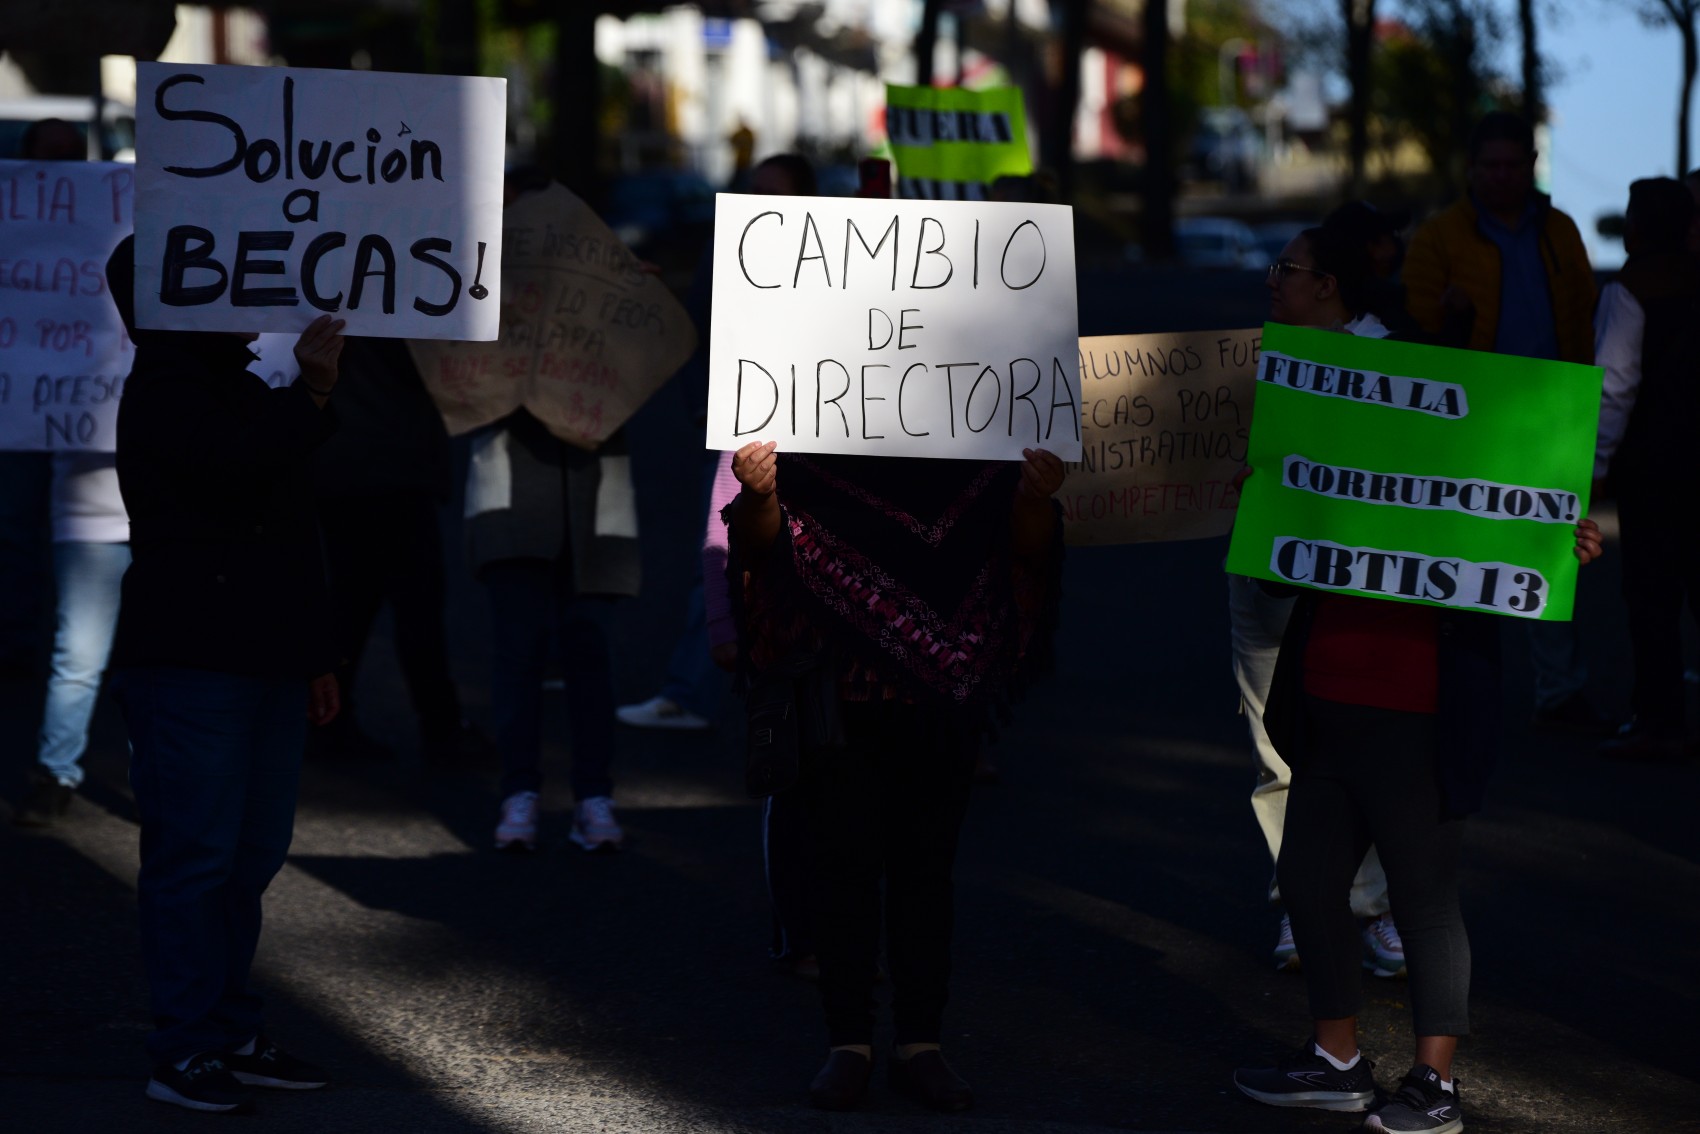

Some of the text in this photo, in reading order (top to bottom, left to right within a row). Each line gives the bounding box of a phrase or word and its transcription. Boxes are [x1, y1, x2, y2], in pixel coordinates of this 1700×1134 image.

[282, 188, 319, 223] a
[158, 225, 489, 316] BECAS!
[738, 211, 1046, 290] CAMBIO
[35, 318, 95, 357] POR
[868, 308, 924, 350] DE
[733, 357, 1080, 443] DIRECTORA
[1178, 386, 1240, 435] POR
[1262, 355, 1461, 417] FUERA LA
[45, 411, 97, 448] NO
[1065, 428, 1249, 474] NISTRATIVOS
[1063, 480, 1239, 521] NCOMPETENTE
[1288, 460, 1577, 521] CORRUPCION!
[1276, 539, 1544, 613] CBTIS 13
